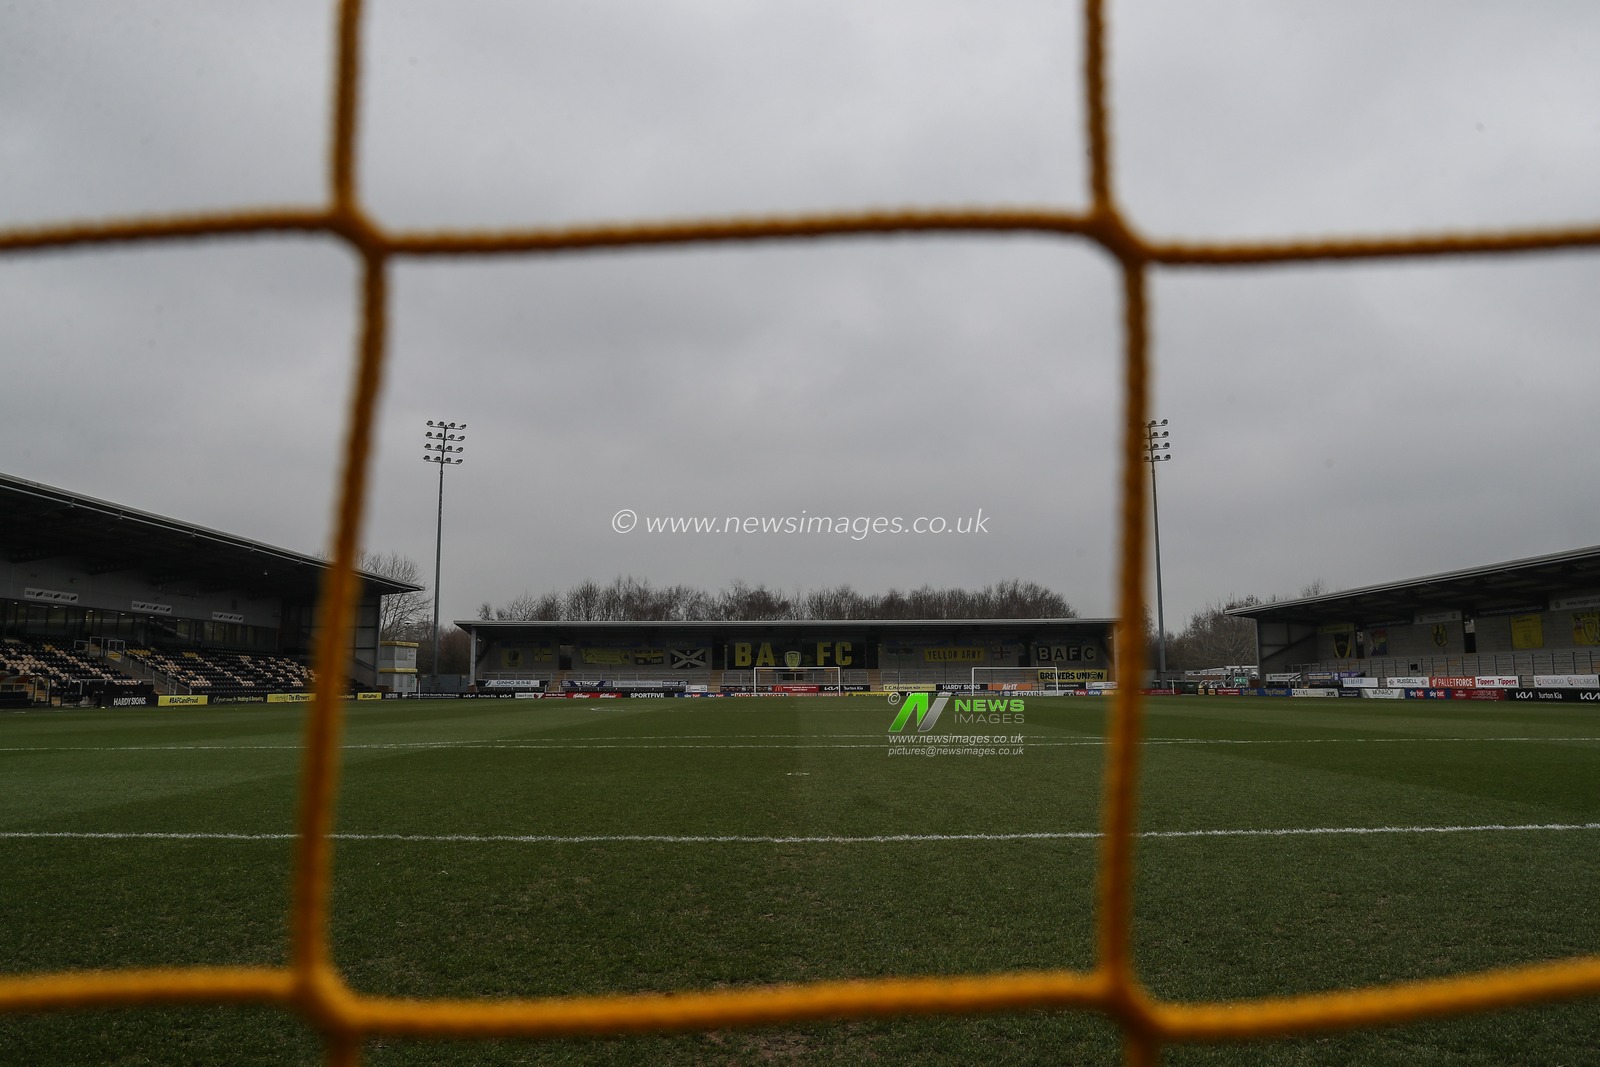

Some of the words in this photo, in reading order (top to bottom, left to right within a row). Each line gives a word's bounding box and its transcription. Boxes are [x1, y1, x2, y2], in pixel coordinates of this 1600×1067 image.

[927, 651, 957, 660] YELLOW
[962, 650, 981, 659] ARMY
[1040, 672, 1075, 680] BREWERS
[1438, 678, 1473, 687] PALLETFORCE
[1477, 678, 1495, 686] Tippers
[1498, 678, 1517, 686] Tippers
[113, 697, 131, 705] HARDY
[131, 697, 146, 705] SIGNS
